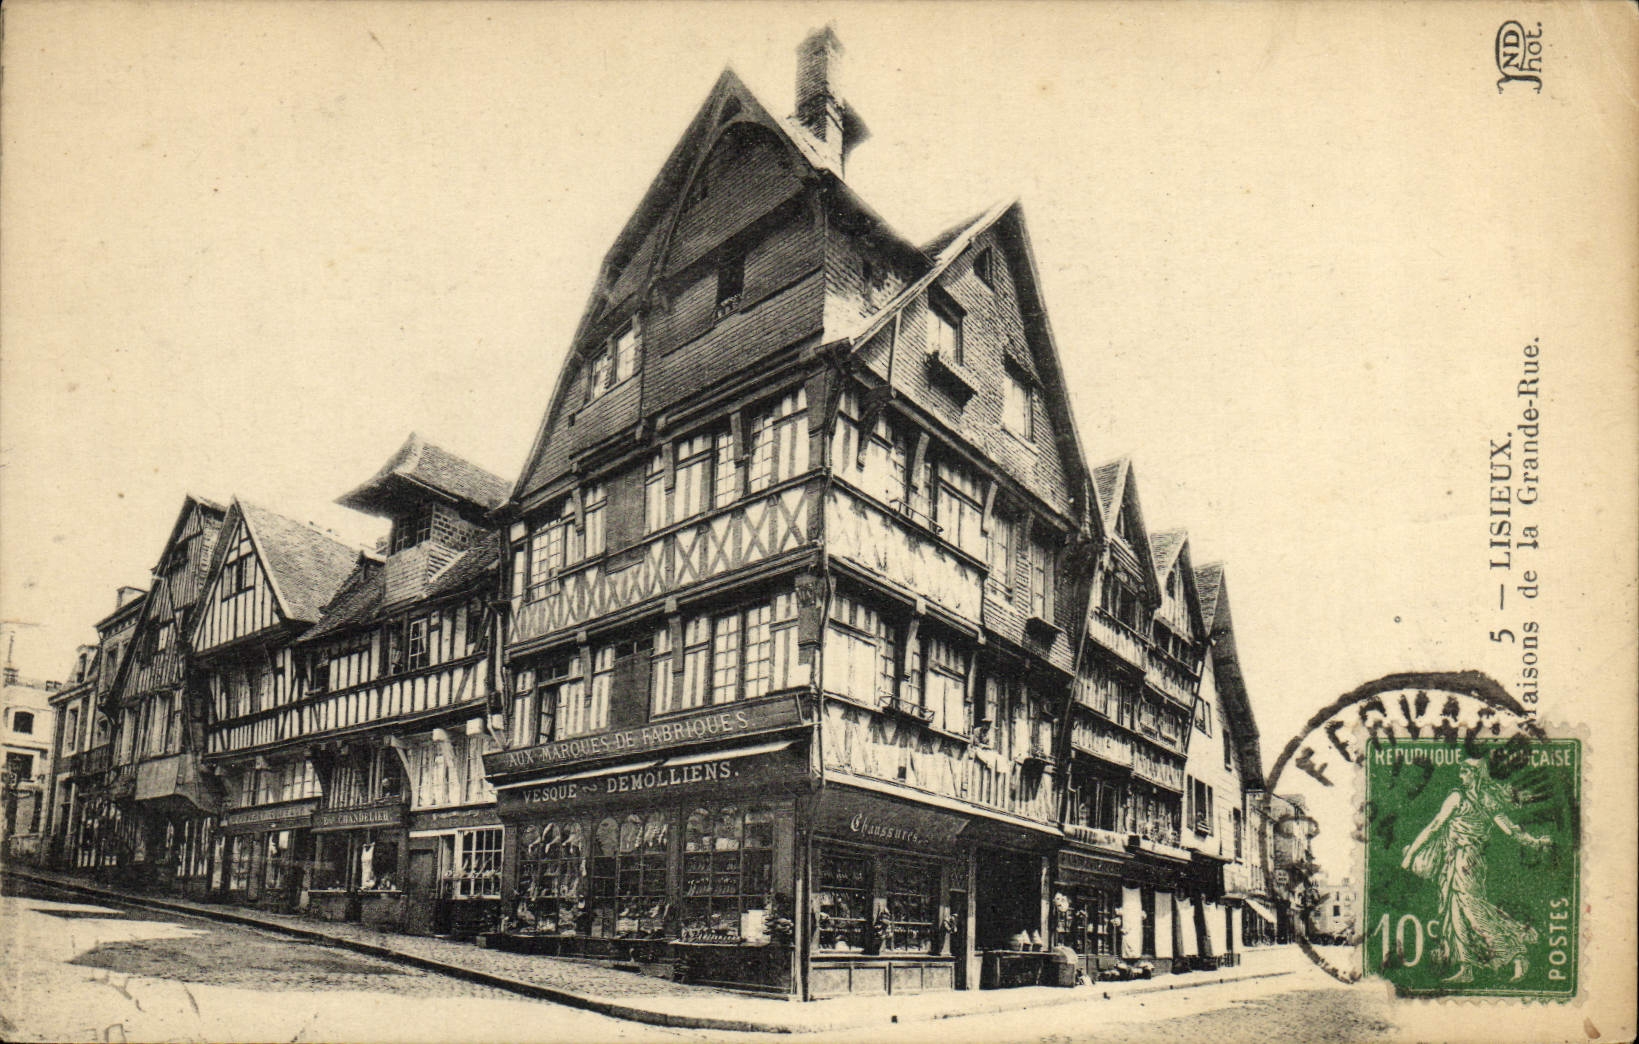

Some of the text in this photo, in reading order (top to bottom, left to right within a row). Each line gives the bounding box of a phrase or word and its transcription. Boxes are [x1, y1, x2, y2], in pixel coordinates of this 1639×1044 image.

[508, 750, 534, 767] AUX
[541, 736, 609, 762] MARQUES
[615, 733, 634, 748] DE
[523, 783, 578, 803] VESQUE
[851, 811, 919, 842] Chaussures
[1549, 897, 1570, 981] POSTES
